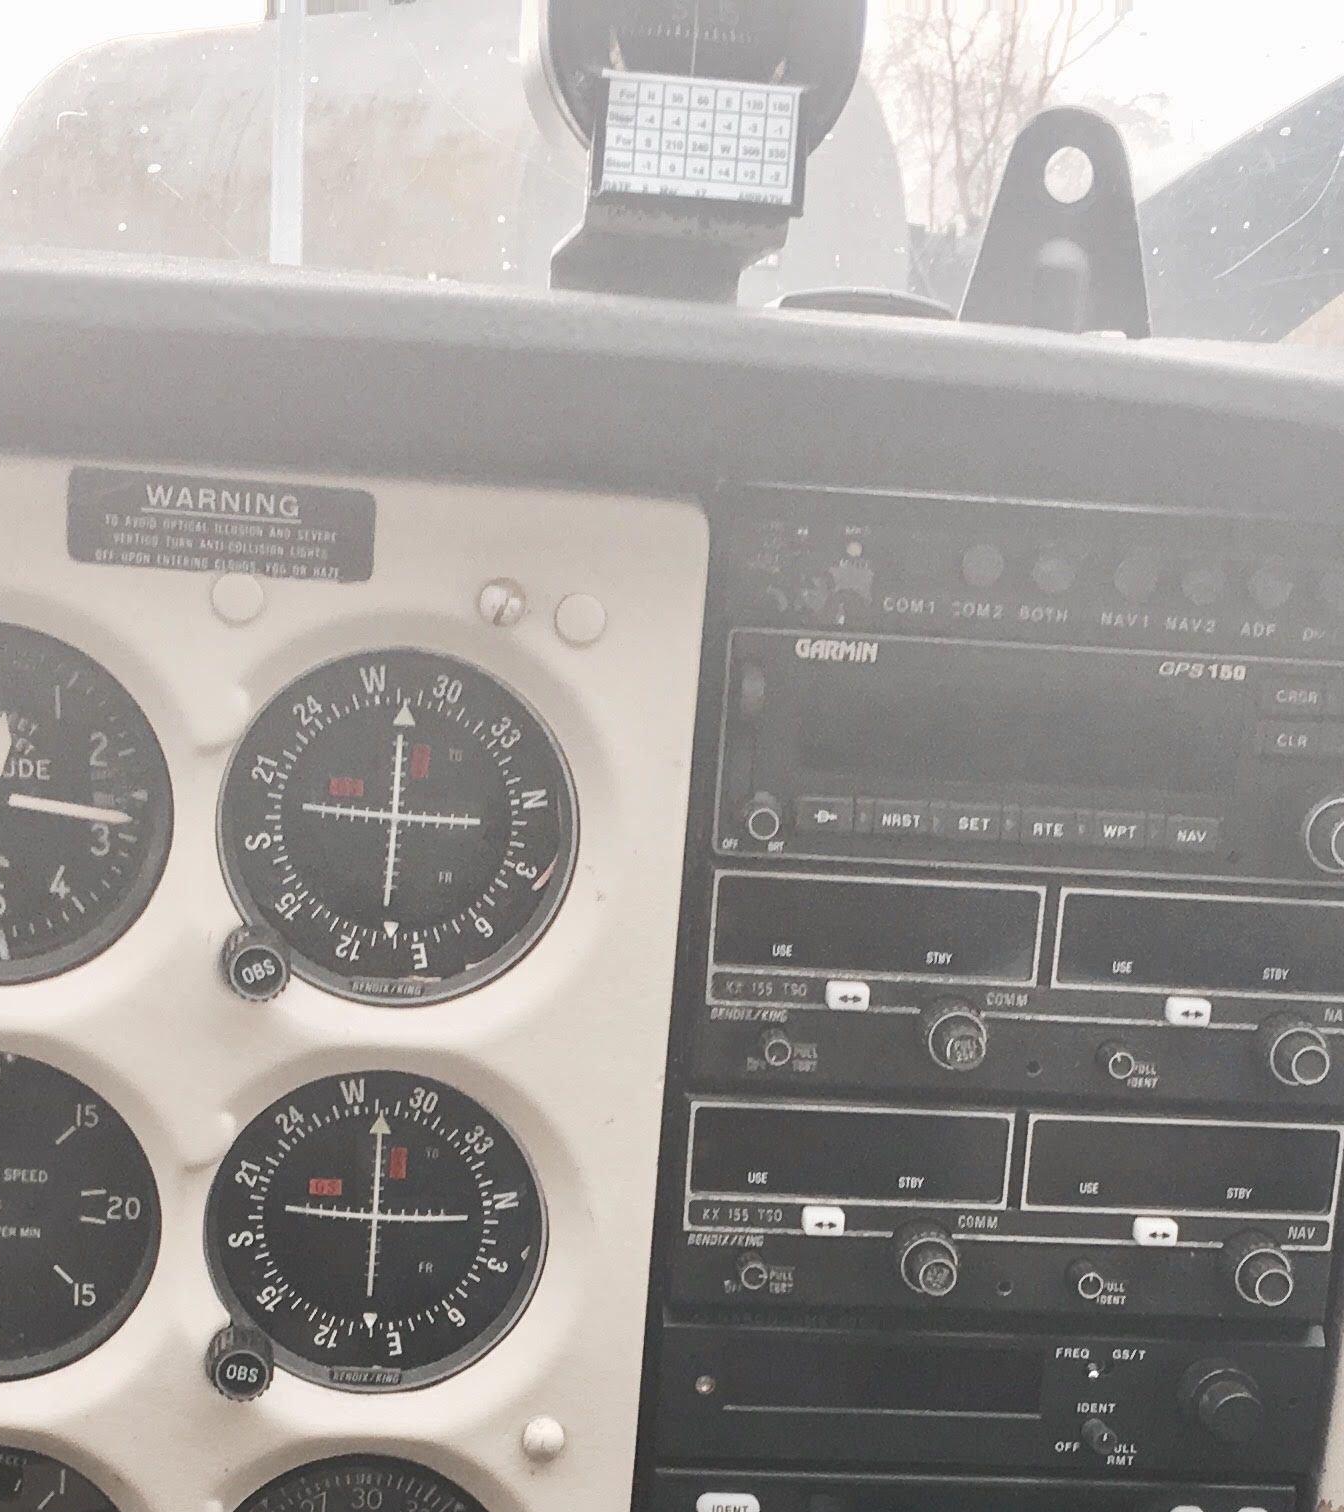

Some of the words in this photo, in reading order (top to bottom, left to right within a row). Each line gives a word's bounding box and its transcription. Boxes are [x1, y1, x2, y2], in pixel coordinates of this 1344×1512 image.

[147, 483, 299, 517] WARNING
[882, 597, 936, 615] COM1
[1019, 605, 1069, 624] BOTH
[1101, 610, 1150, 628] NAV1
[795, 638, 878, 664] GARMIN
[1158, 660, 1203, 679] GPS
[360, 665, 386, 693] W
[433, 675, 462, 702] 30
[90, 732, 107, 767] 2
[958, 816, 990, 833] SET
[1103, 822, 1137, 841] WPT
[91, 824, 110, 857] 3
[1177, 826, 1208, 843] NAV
[50, 865, 70, 898] 4
[772, 944, 792, 957] USE
[241, 959, 276, 984] OBS
[1112, 961, 1133, 974] USE
[1262, 967, 1290, 981] STBY
[986, 992, 1028, 1007] COMM
[340, 1079, 366, 1104] W
[409, 1087, 439, 1113] 30
[76, 1103, 99, 1127] 15
[4, 1169, 48, 1182] SPEED
[898, 1176, 925, 1189] STBY
[1080, 1182, 1099, 1194] USE
[1226, 1187, 1253, 1199] STBY
[107, 1197, 141, 1220] 20
[958, 1215, 999, 1230] COMM
[21, 1226, 41, 1238] MIN
[1288, 1227, 1316, 1240] NAV
[74, 1284, 96, 1306] 15
[1056, 1347, 1090, 1359] FREQ
[1112, 1348, 1146, 1362] GS/T
[226, 1364, 259, 1383] OBS
[1077, 1402, 1115, 1414] IDENT
[1055, 1441, 1080, 1453] OFF
[1106, 1454, 1134, 1467] RMT
[350, 1489, 384, 1510] 30
